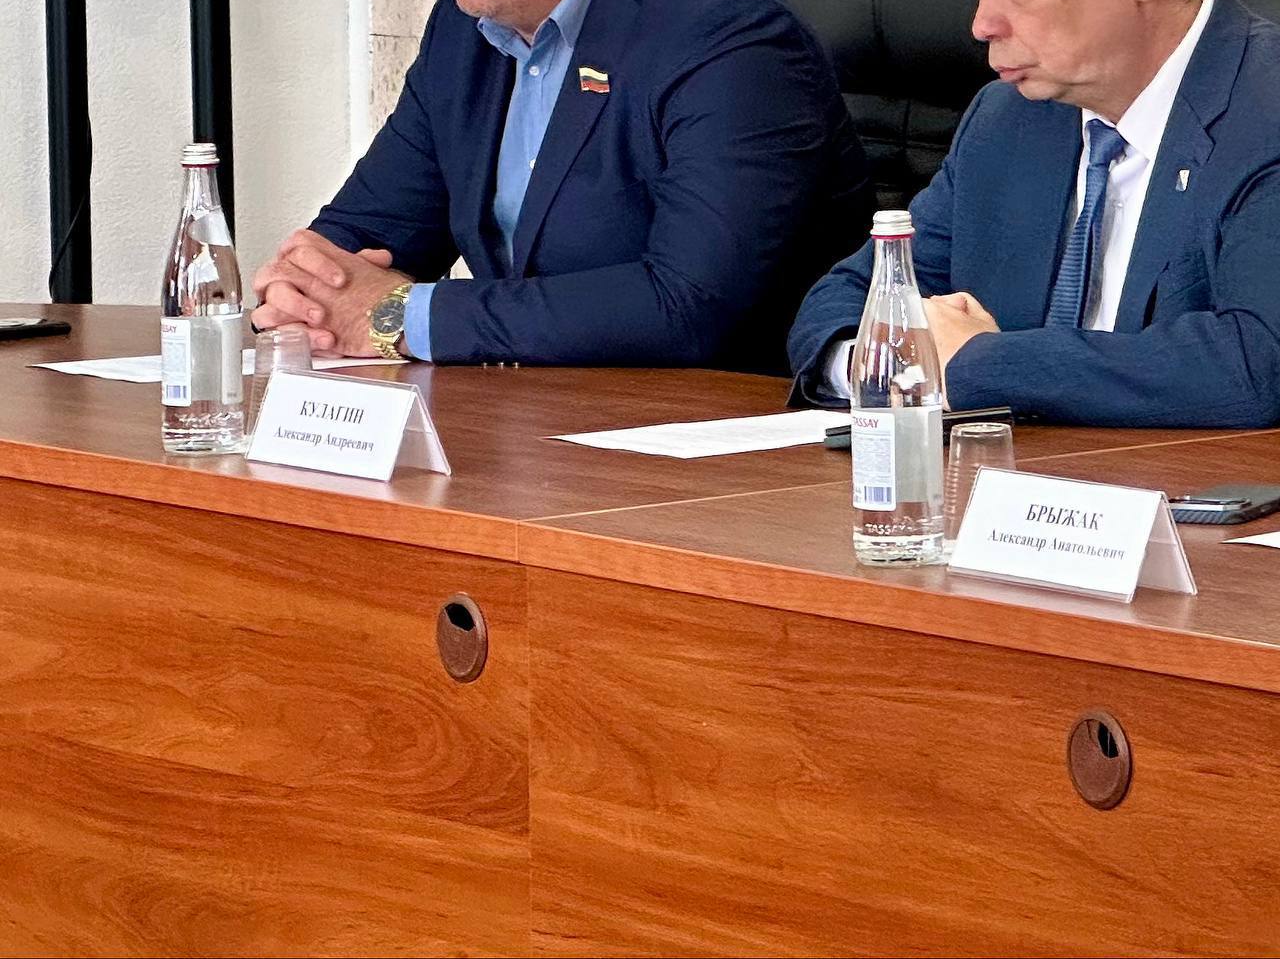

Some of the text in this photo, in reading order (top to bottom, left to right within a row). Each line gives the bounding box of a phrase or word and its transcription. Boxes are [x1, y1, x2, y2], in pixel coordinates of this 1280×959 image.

[299, 400, 365, 425] КУЛАГИН
[274, 426, 375, 452] Александр Андреевич
[1025, 503, 1104, 531] БРЫЖАК
[987, 529, 1126, 561] Александр Анатольевич
